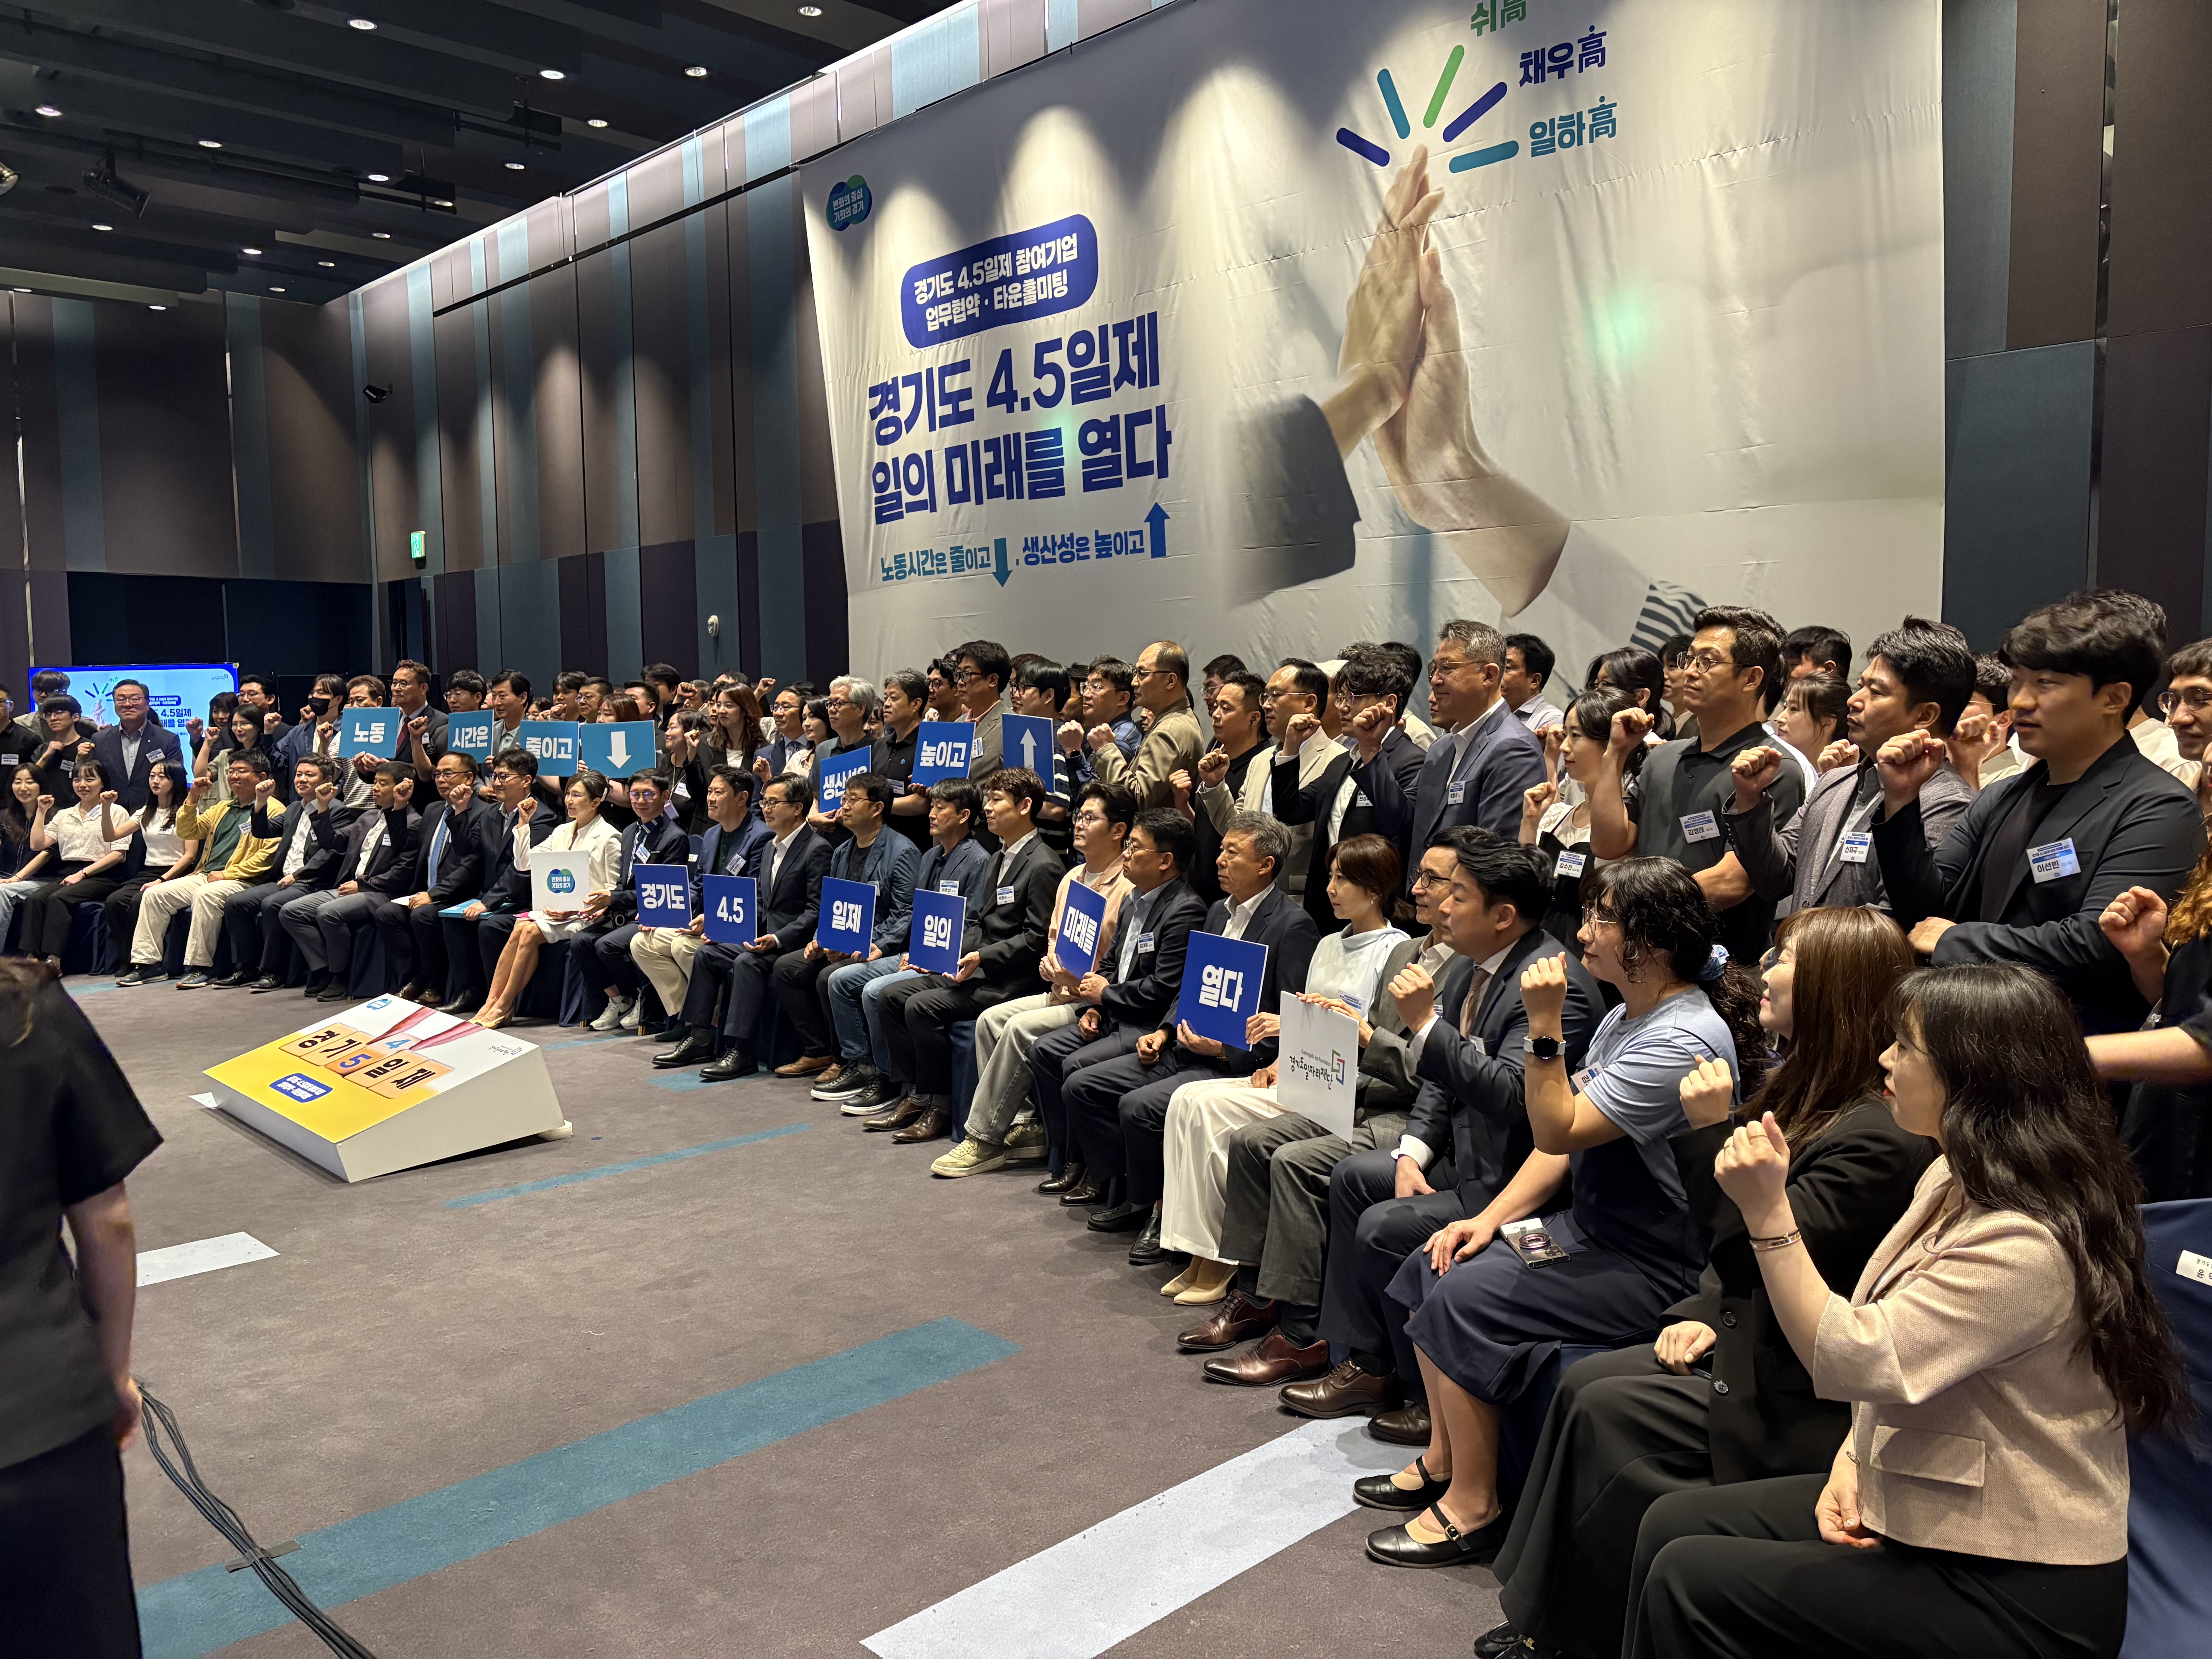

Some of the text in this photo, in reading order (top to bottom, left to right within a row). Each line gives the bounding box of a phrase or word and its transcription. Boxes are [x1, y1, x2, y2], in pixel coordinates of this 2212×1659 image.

[833, 187, 863, 211] 변화의 중심
[834, 200, 864, 223] 기회의 경기
[914, 232, 1078, 305] 경기도 4.5일제 참여기업
[925, 294, 981, 332] 업무협약
[993, 269, 1068, 311] 타운홀미팅
[868, 311, 1160, 446] 경기도 4.5일제
[871, 404, 1173, 525] 일의 미래를 열다
[881, 529, 1145, 582] 노동시간은 줄이고 생산성은 높이고
[353, 722, 385, 743] 노동
[452, 726, 488, 749] 시간은
[526, 737, 572, 759] 줄이고
[920, 741, 967, 768] 높이고
[2037, 860, 2060, 872] 이선빈
[641, 883, 685, 909] 경기도
[717, 896, 744, 923] 4.5
[831, 900, 862, 933] 일제
[923, 914, 952, 950] 일의
[1063, 905, 1098, 956] 미래를
[1199, 964, 1243, 1012] 열다
[1290, 1056, 1333, 1090] 경기도일자리재단
